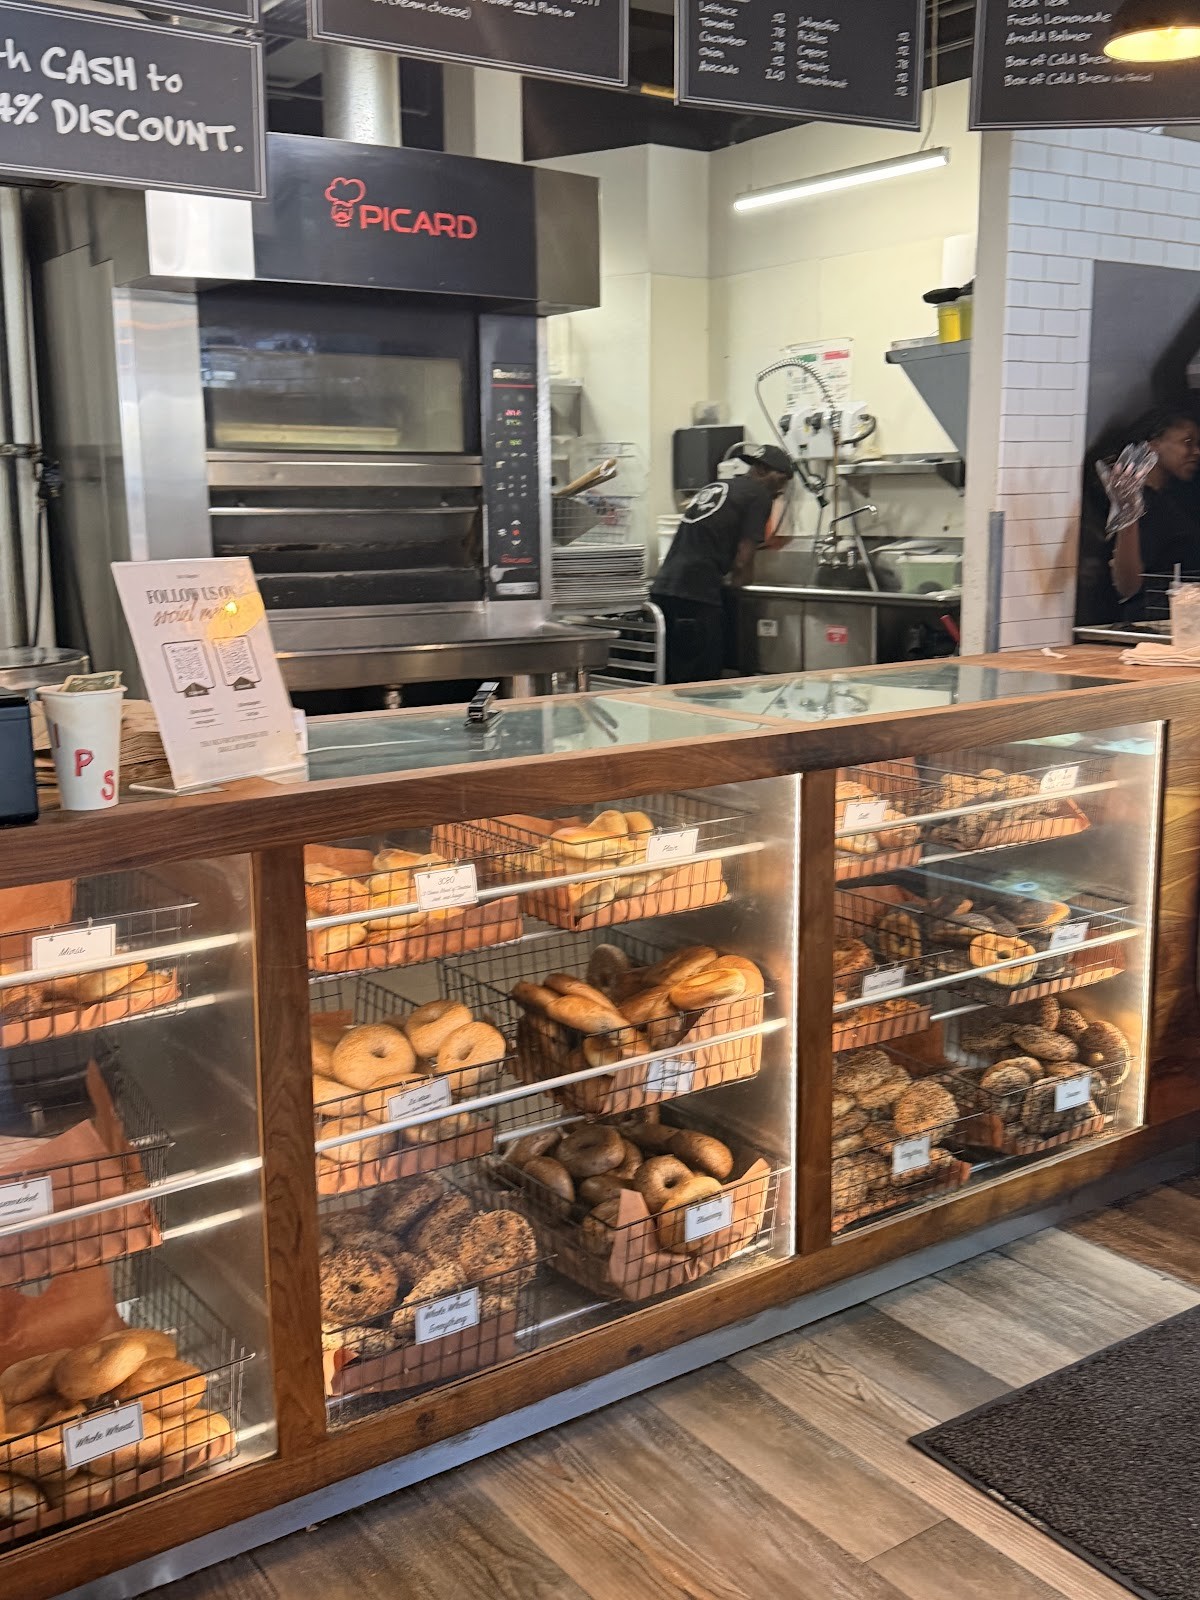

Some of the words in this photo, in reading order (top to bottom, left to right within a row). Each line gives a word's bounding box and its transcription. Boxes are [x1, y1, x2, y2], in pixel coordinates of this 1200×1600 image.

[1043, 12, 1112, 25] Lemonade
[0, 38, 32, 73] h
[41, 46, 138, 91] CASH
[147, 63, 183, 93] to
[51, 98, 244, 153] DISCOUNT.
[359, 204, 478, 240] PICARD
[75, 1431, 103, 1449] Whole
[105, 1420, 135, 1437] Wheat
